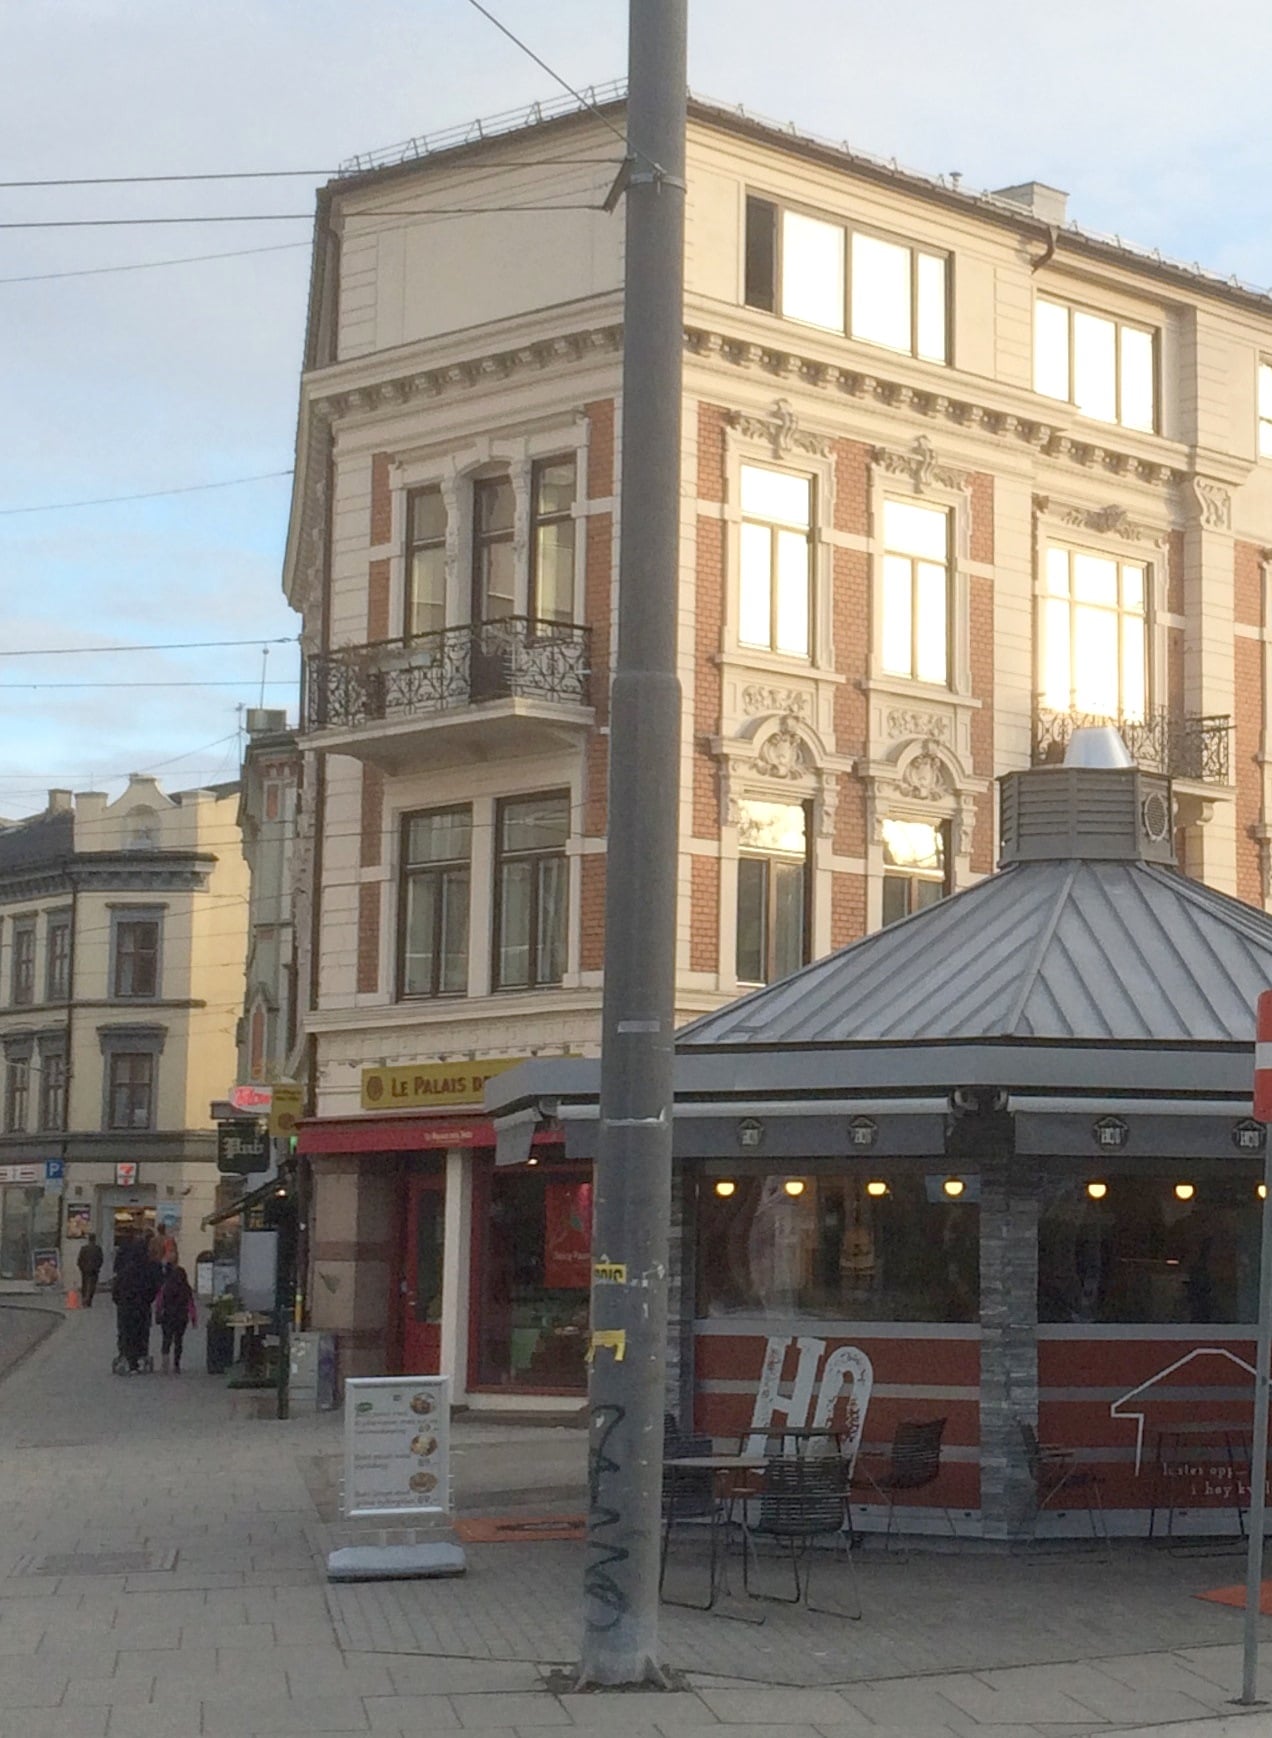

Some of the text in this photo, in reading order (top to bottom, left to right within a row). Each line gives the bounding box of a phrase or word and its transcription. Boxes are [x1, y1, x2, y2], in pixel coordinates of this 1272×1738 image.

[391, 1077, 408, 1098] LE
[414, 1076, 466, 1096] PALAIS
[222, 1136, 264, 1158] Pub
